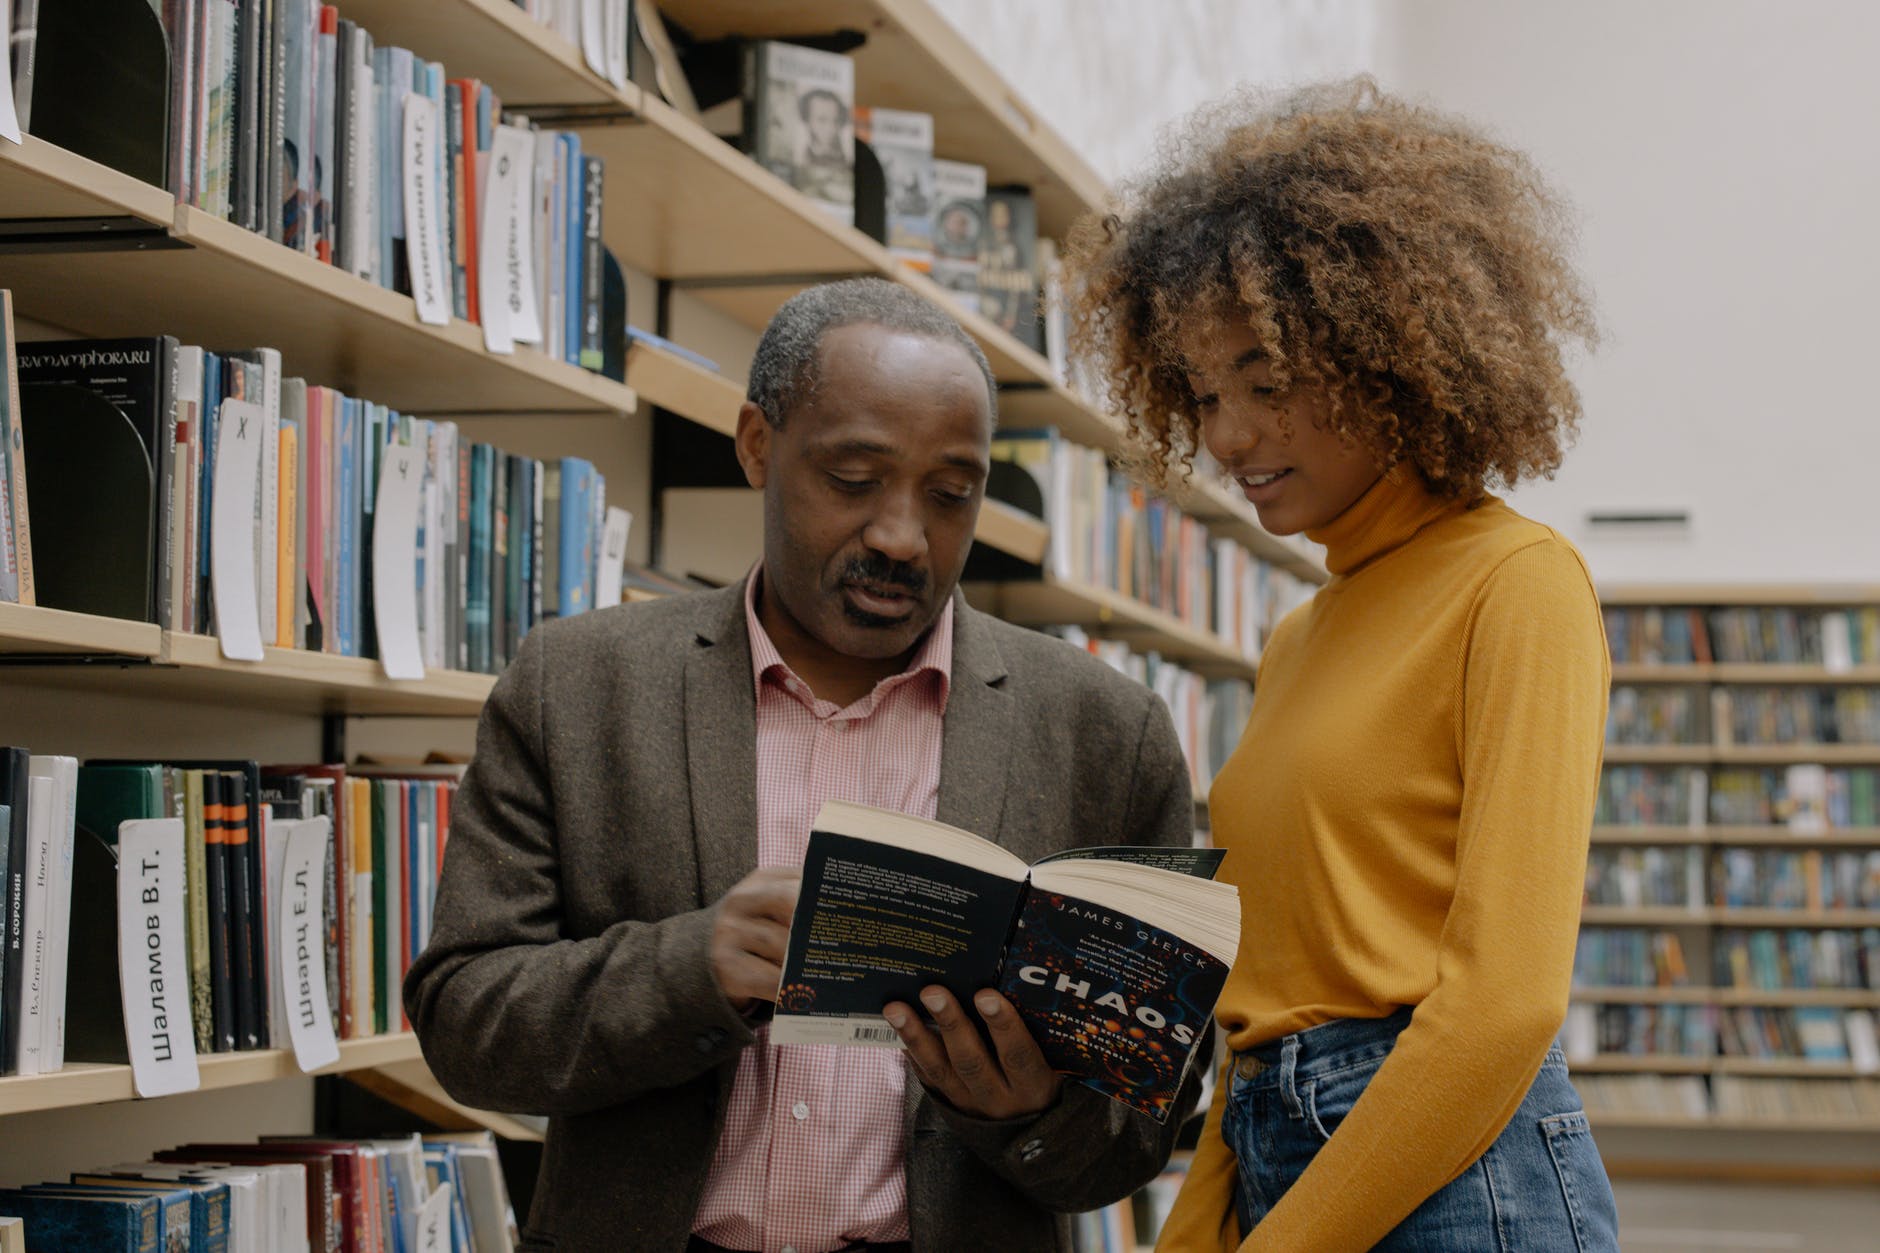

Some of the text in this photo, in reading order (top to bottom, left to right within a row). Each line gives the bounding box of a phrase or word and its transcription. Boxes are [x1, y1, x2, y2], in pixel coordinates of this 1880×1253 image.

[17, 522, 32, 594] ГОЛОВА
[142, 848, 173, 1063] Шаламов В.Т.
[293, 859, 317, 1028] Шварц Е.Л.
[1057, 902, 1208, 970] JAMES GLEICK
[1017, 964, 1196, 1046] CHAOS
[1052, 1011, 1139, 1049] AMAZING SCIENCE
[1090, 1014, 1109, 1025] THE
[1092, 1034, 1111, 1044] THE
[1048, 1028, 1131, 1064] UNPREDICTABLE
